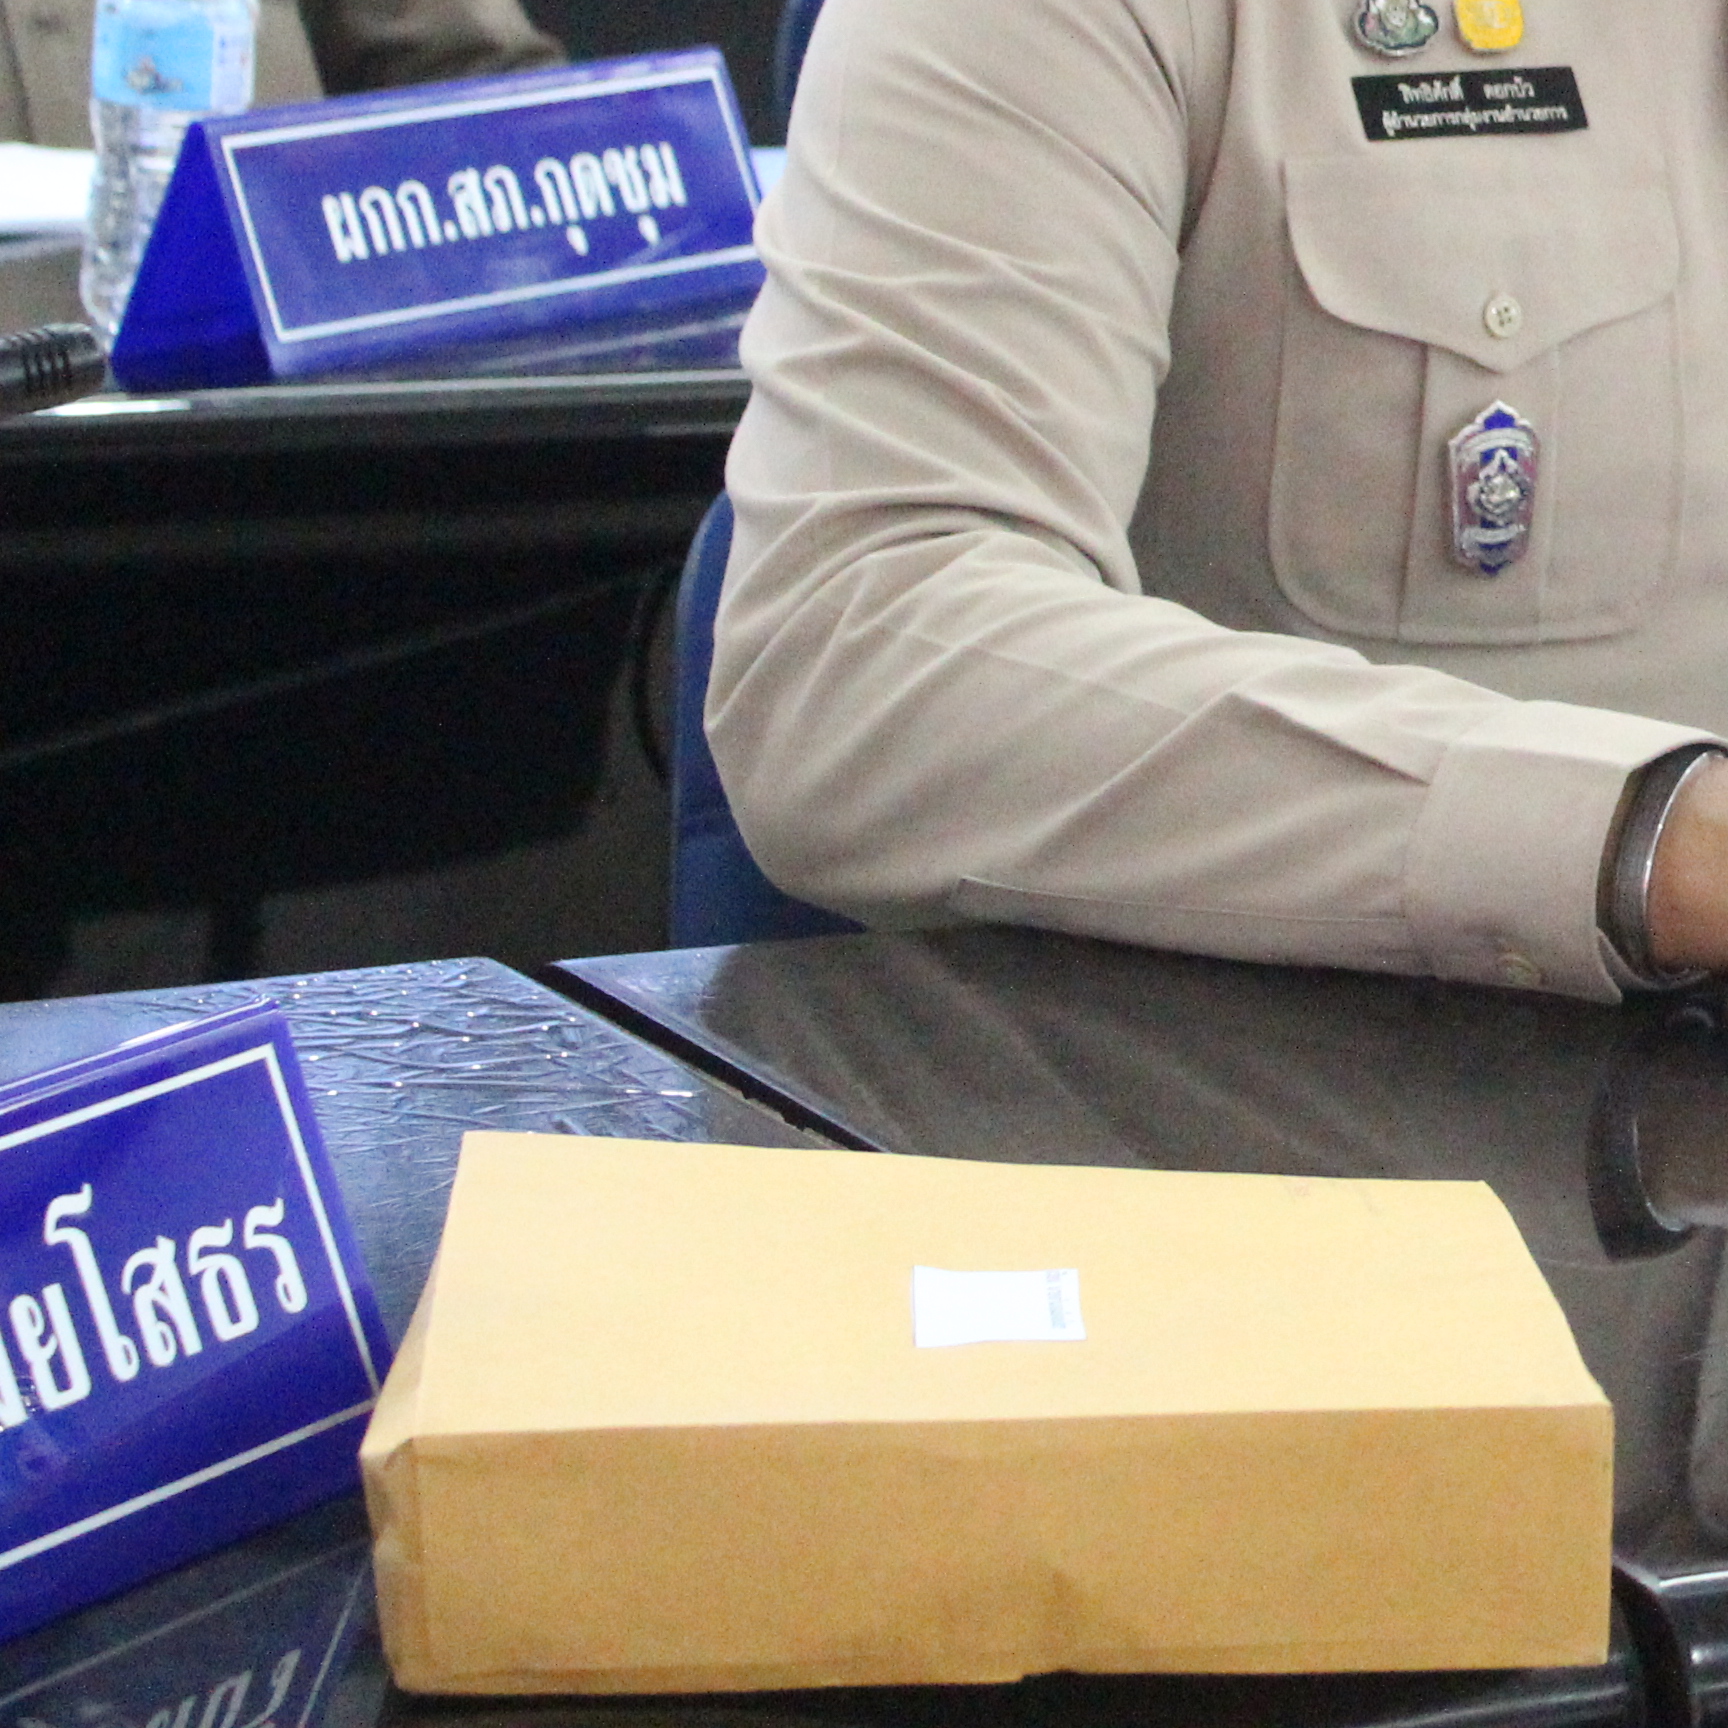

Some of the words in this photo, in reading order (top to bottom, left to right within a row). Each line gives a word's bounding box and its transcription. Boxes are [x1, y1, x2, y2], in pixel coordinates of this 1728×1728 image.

[321, 138, 688, 262] ผกก.สภ.กุดชุม
